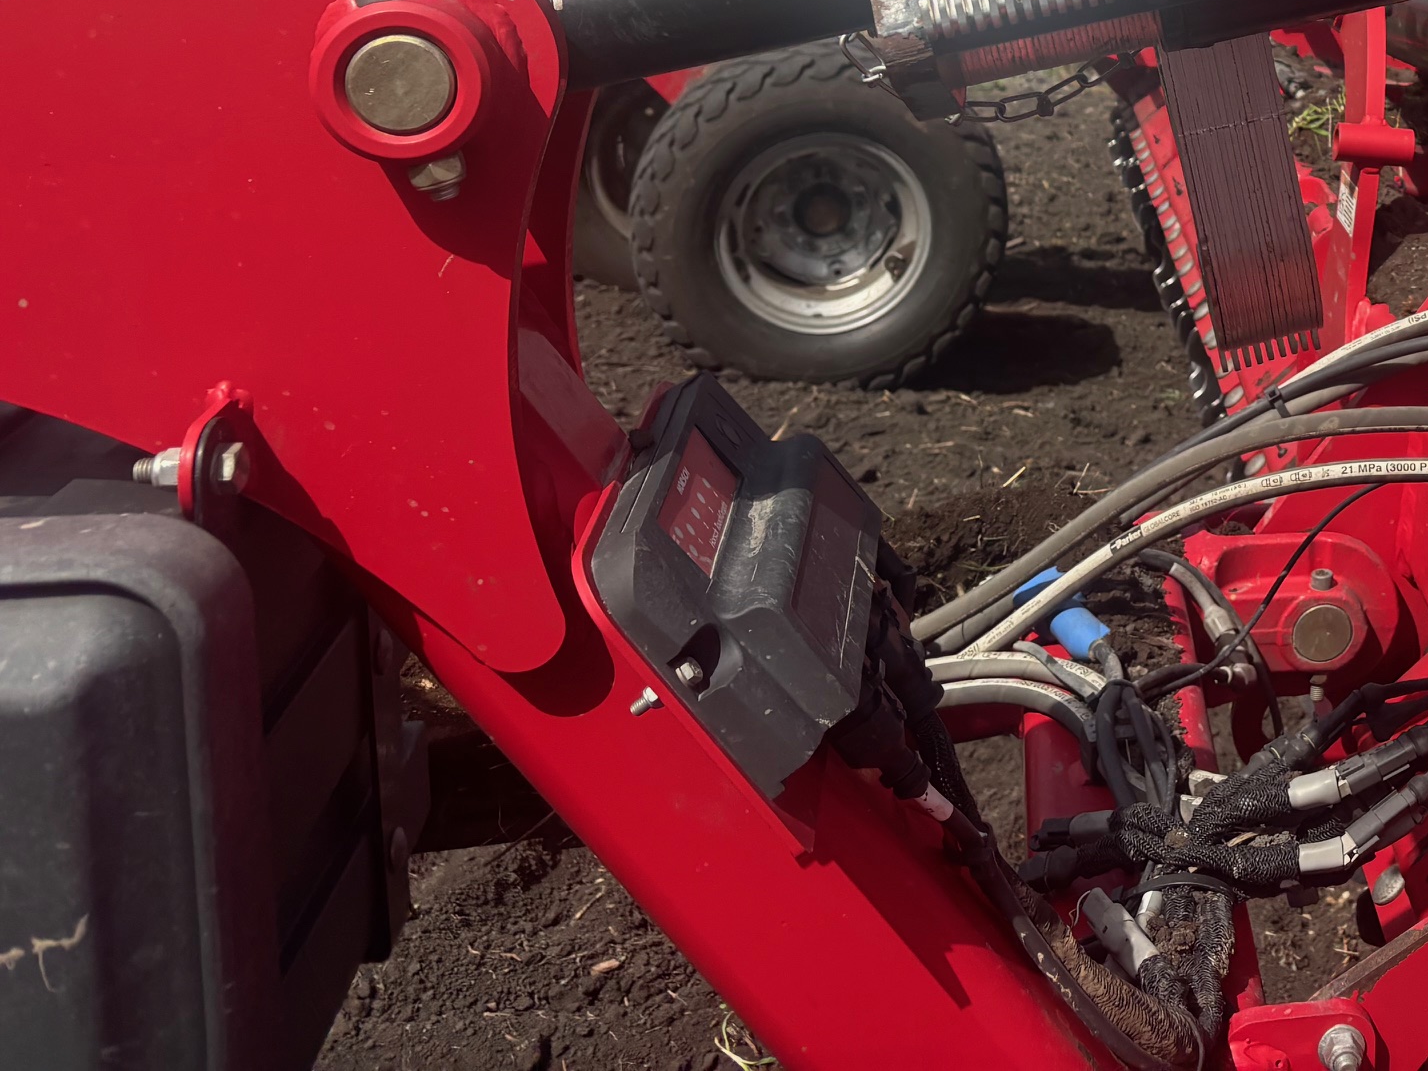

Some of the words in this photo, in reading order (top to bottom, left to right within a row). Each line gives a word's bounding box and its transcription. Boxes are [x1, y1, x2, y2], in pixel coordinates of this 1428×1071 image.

[1408, 313, 1427, 324] PSI)
[1341, 466, 1353, 475] 21
[1358, 464, 1382, 474] MPa
[1385, 462, 1416, 473] (3000
[1114, 529, 1142, 550] Parker
